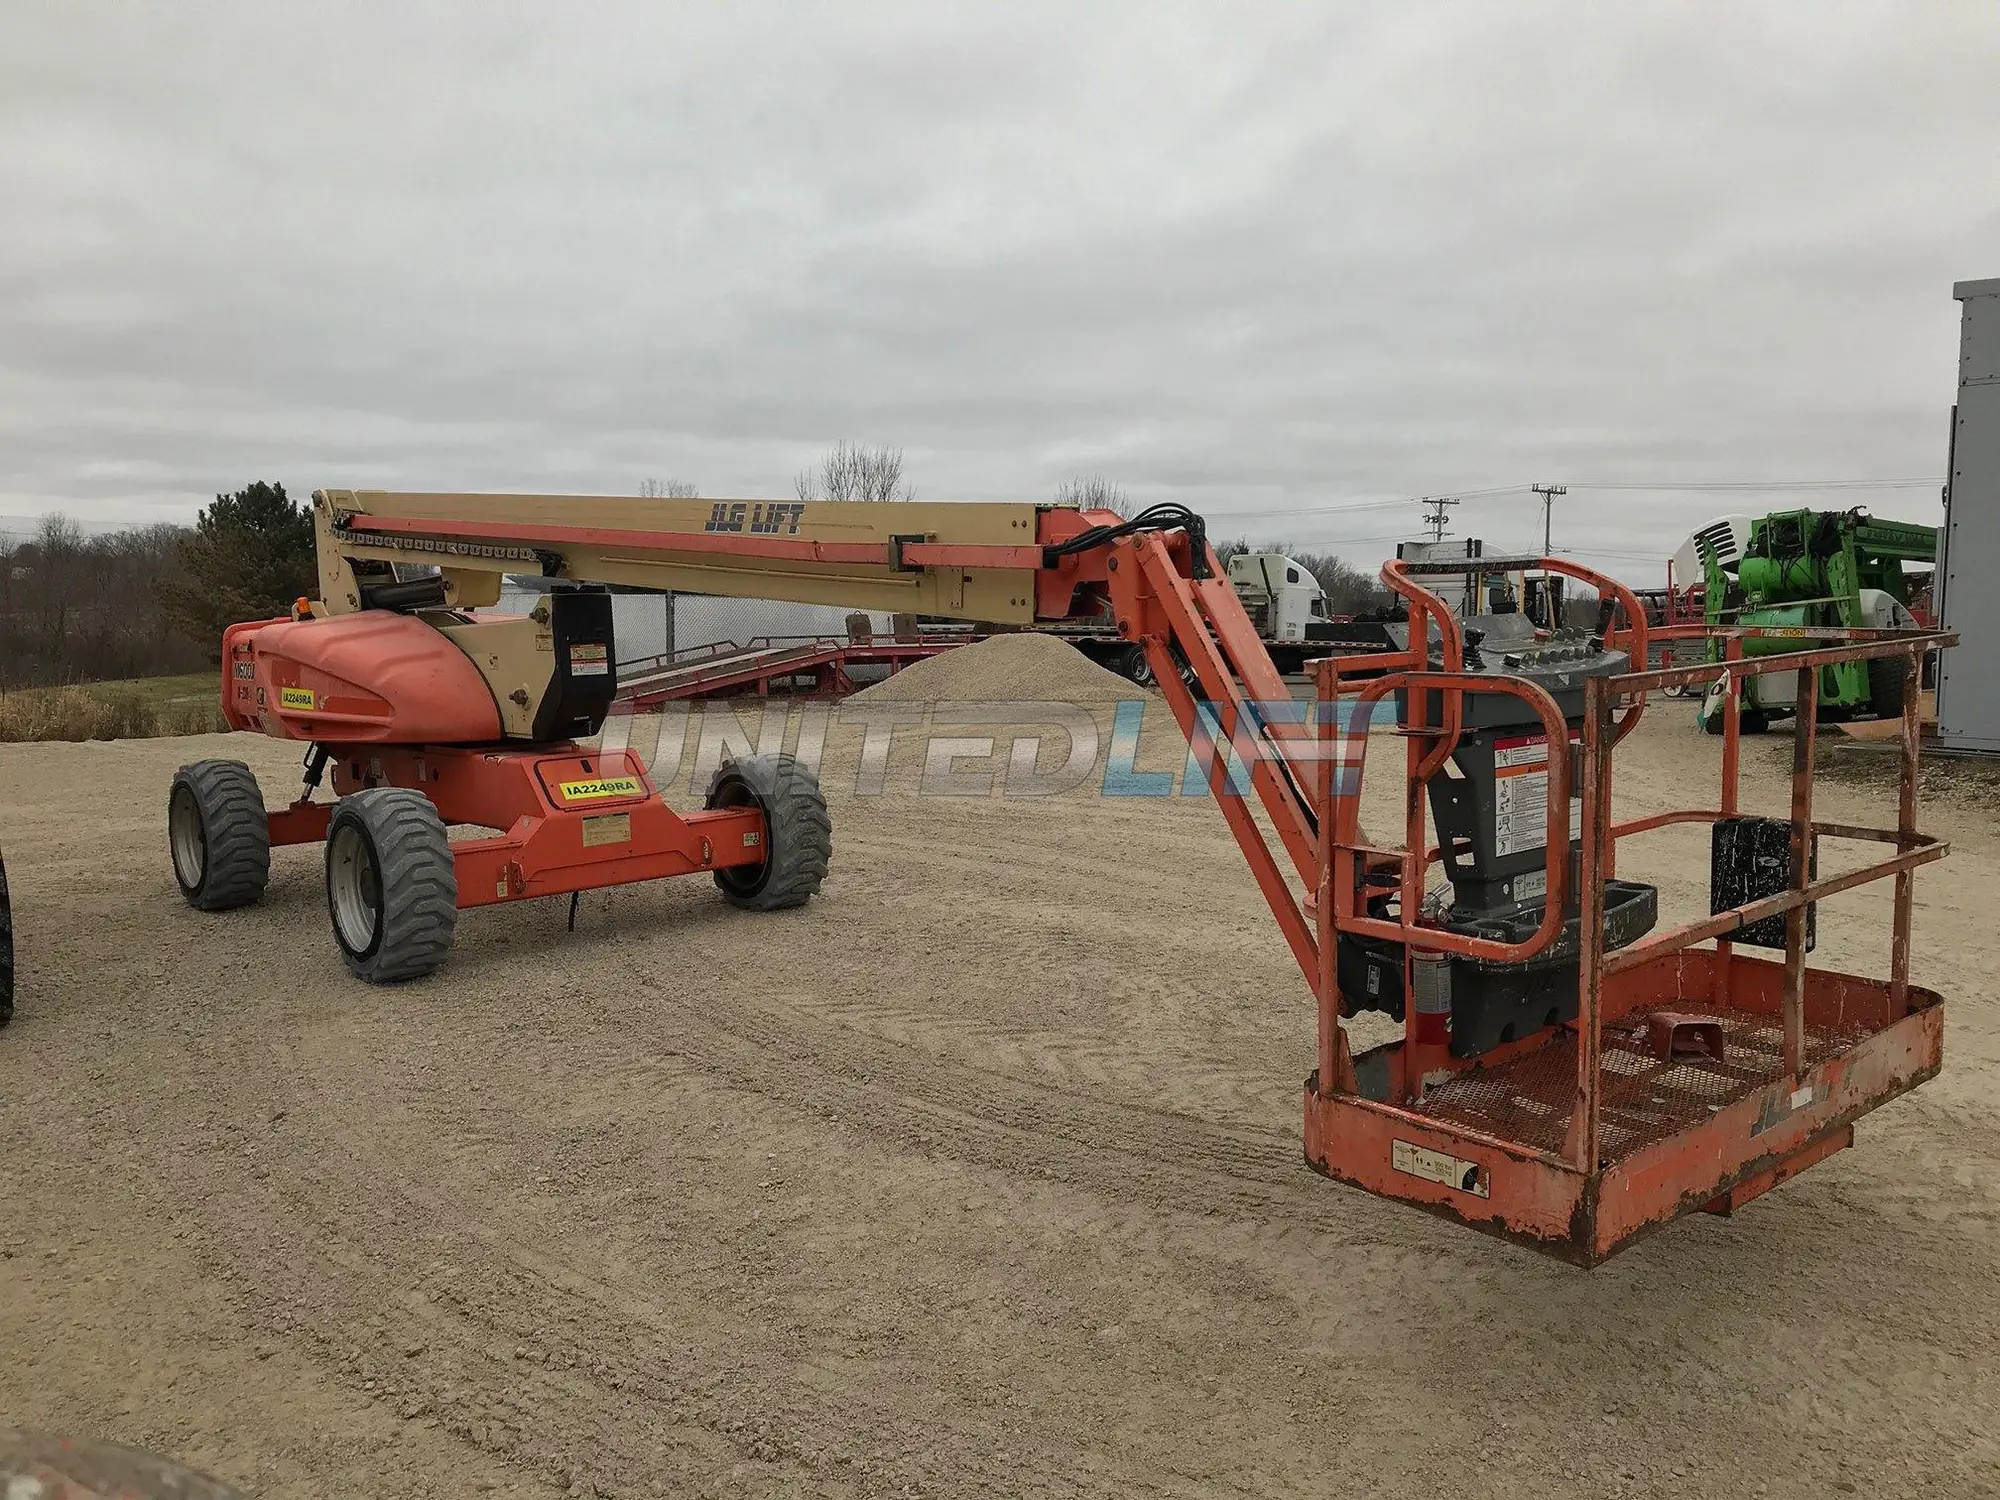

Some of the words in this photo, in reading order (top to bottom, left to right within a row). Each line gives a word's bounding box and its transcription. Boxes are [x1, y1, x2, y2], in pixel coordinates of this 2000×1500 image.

[705, 502, 747, 533] JLG
[750, 503, 806, 536] LIFT
[1530, 735, 1549, 744] DANGE
[566, 782, 635, 795] IA2249RA
